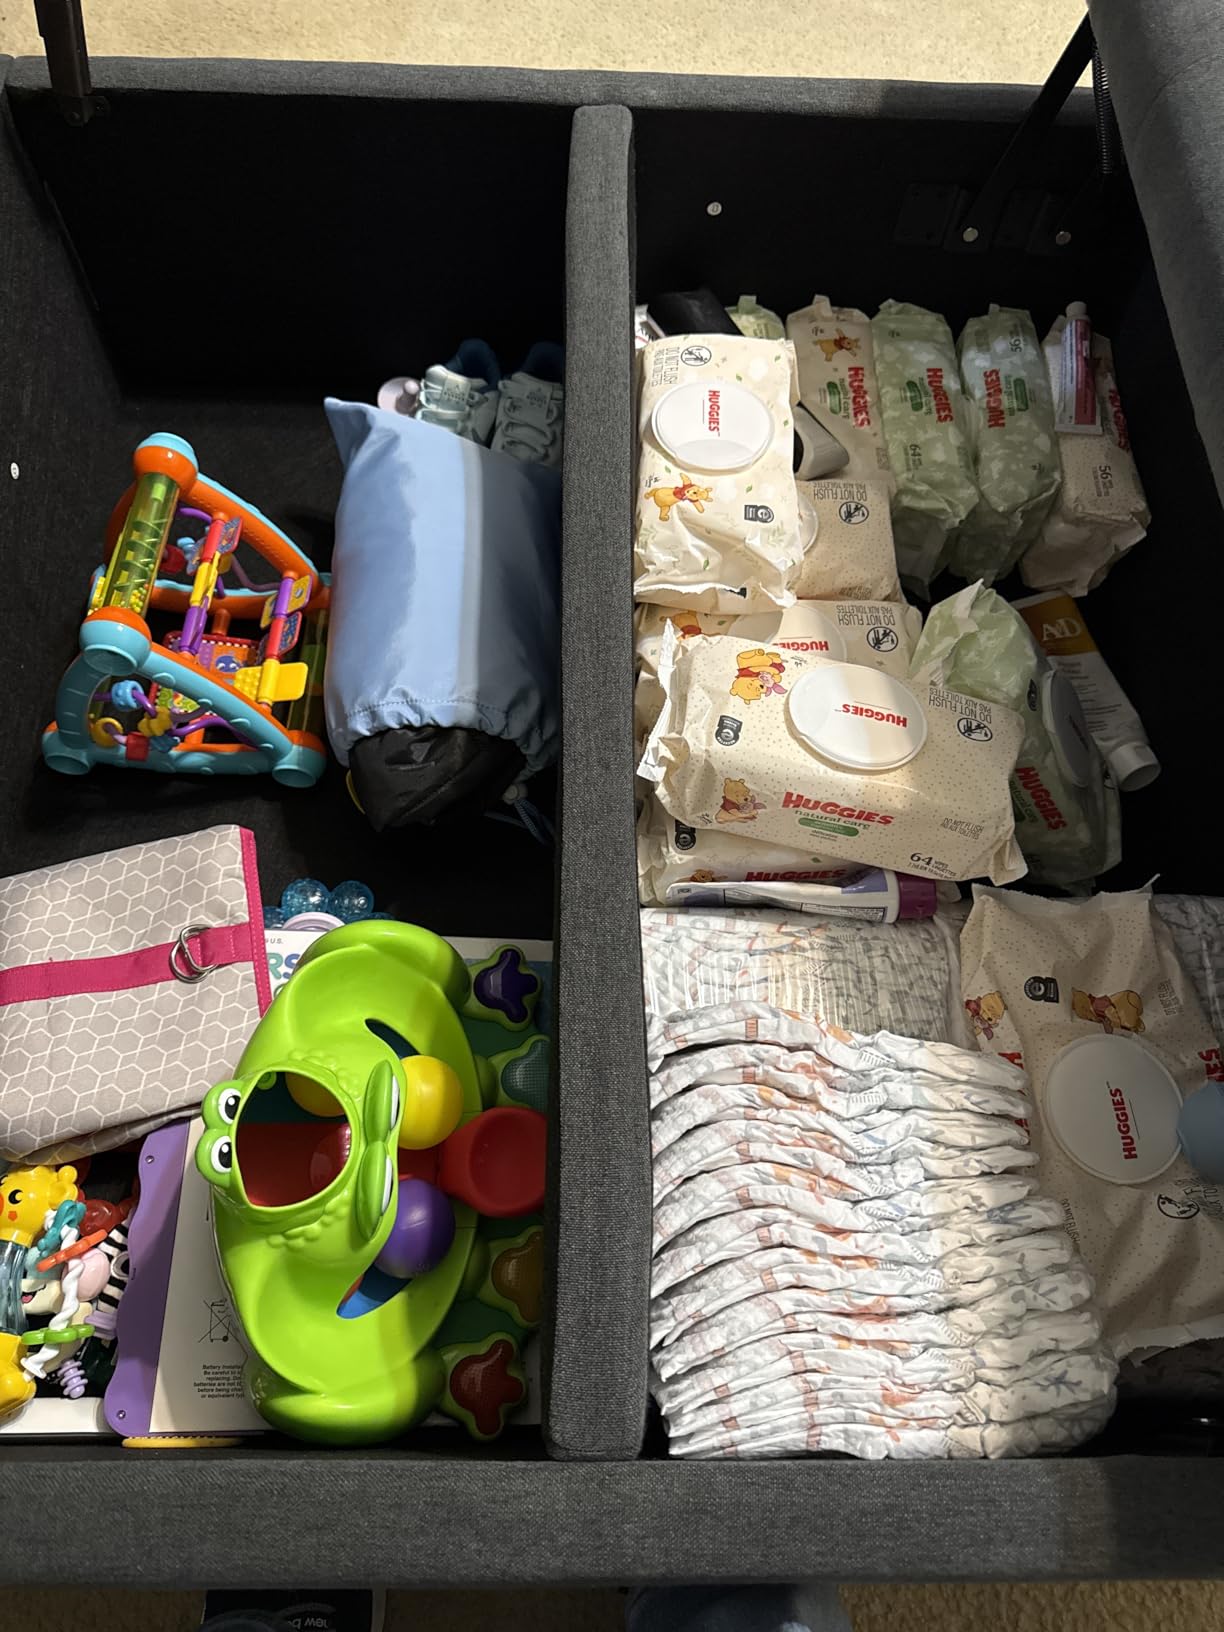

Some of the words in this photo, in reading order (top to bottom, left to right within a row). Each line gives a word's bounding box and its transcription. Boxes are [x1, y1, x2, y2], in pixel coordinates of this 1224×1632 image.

[1009, 337, 1022, 353] 56
[848, 366, 870, 428] HUGGIES
[926, 368, 954, 423] HUGGIES
[983, 368, 1005, 428] HUGGIES
[708, 390, 720, 432] HUGGIES
[1099, 465, 1112, 480] 56
[838, 614, 864, 625] FLUSH
[866, 614, 882, 625] NOT
[882, 615, 896, 626] DO
[772, 640, 829, 651] HUGGIE
[929, 687, 963, 704] TOILETTES
[964, 697, 977, 709] AUX
[928, 696, 957, 713] FLUSH
[959, 704, 977, 718] NOT
[978, 702, 991, 714] PAS
[842, 703, 908, 728] HUGGIES
[979, 710, 991, 724] DO
[1014, 766, 1068, 830] HUGGIES
[781, 791, 895, 825] HUGGIES
[794, 810, 841, 823] natural
[910, 852, 933, 866] 64
[1110, 1088, 1138, 1160] HUGGIES
